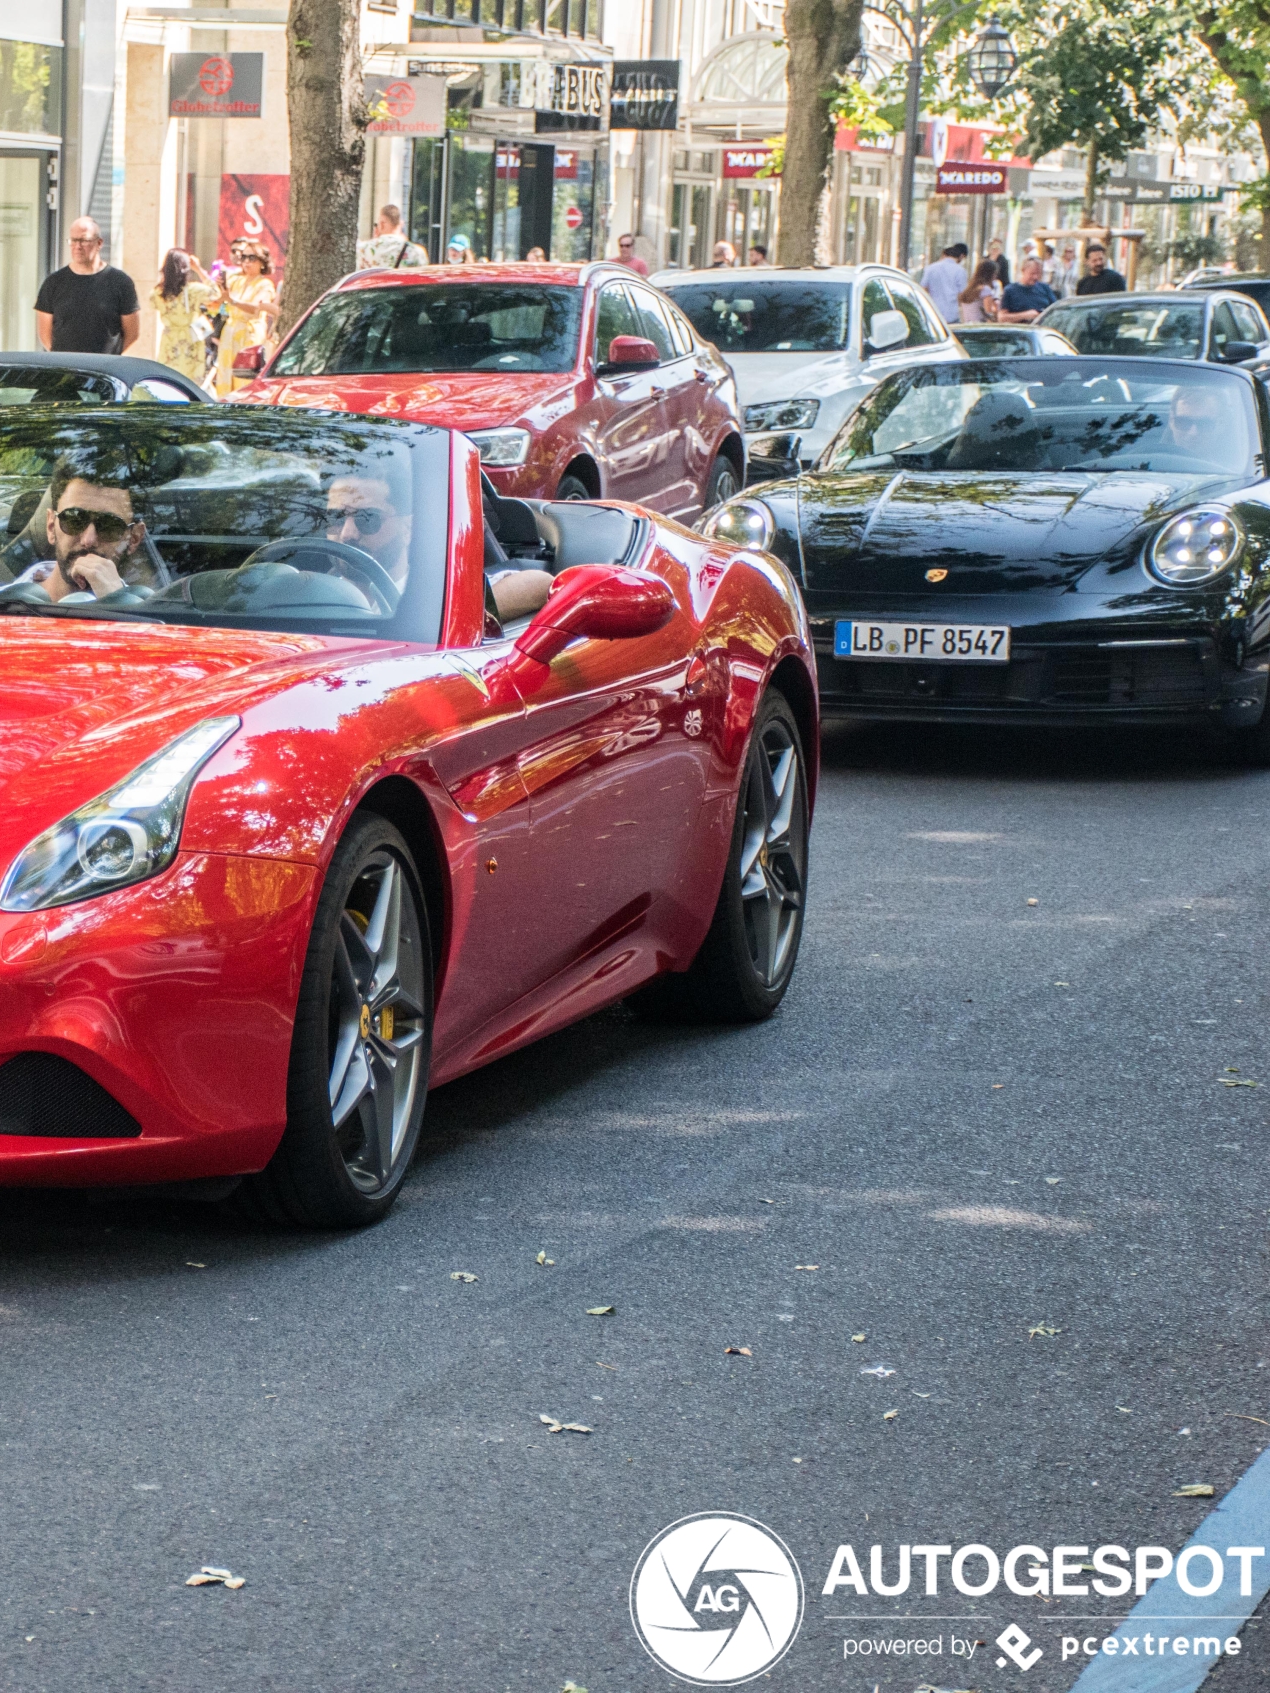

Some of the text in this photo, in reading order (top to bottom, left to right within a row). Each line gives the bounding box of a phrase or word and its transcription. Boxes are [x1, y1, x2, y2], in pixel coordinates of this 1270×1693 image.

[853, 626, 883, 652] LB
[903, 628, 935, 653] PF
[942, 629, 1005, 655] 8547
